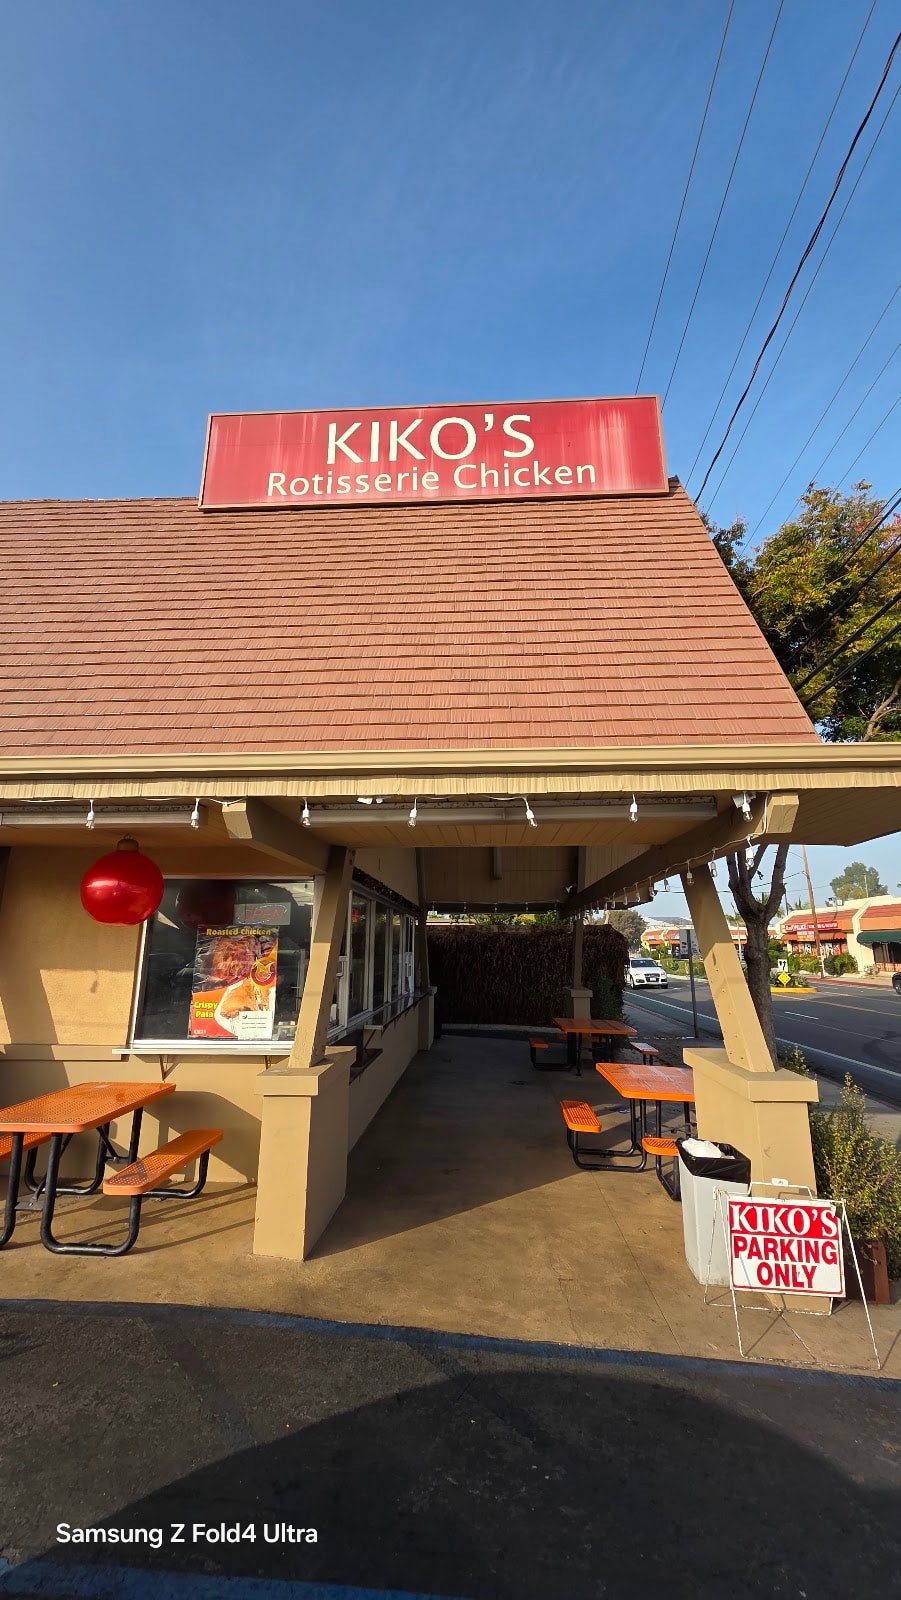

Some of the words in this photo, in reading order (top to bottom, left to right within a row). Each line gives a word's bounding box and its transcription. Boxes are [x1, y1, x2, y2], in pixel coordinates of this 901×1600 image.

[326, 413, 536, 466] KIKO'S
[266, 470, 440, 497] Rotisserie
[453, 461, 597, 491] Chicken
[206, 927, 239, 936] Roasted
[240, 927, 271, 936] Chicken
[194, 1001, 218, 1010] Crispy
[195, 1010, 214, 1018] Pata
[730, 1204, 838, 1238] KIKO'S
[733, 1235, 838, 1265] PARKING
[756, 1261, 818, 1289] ONLY
